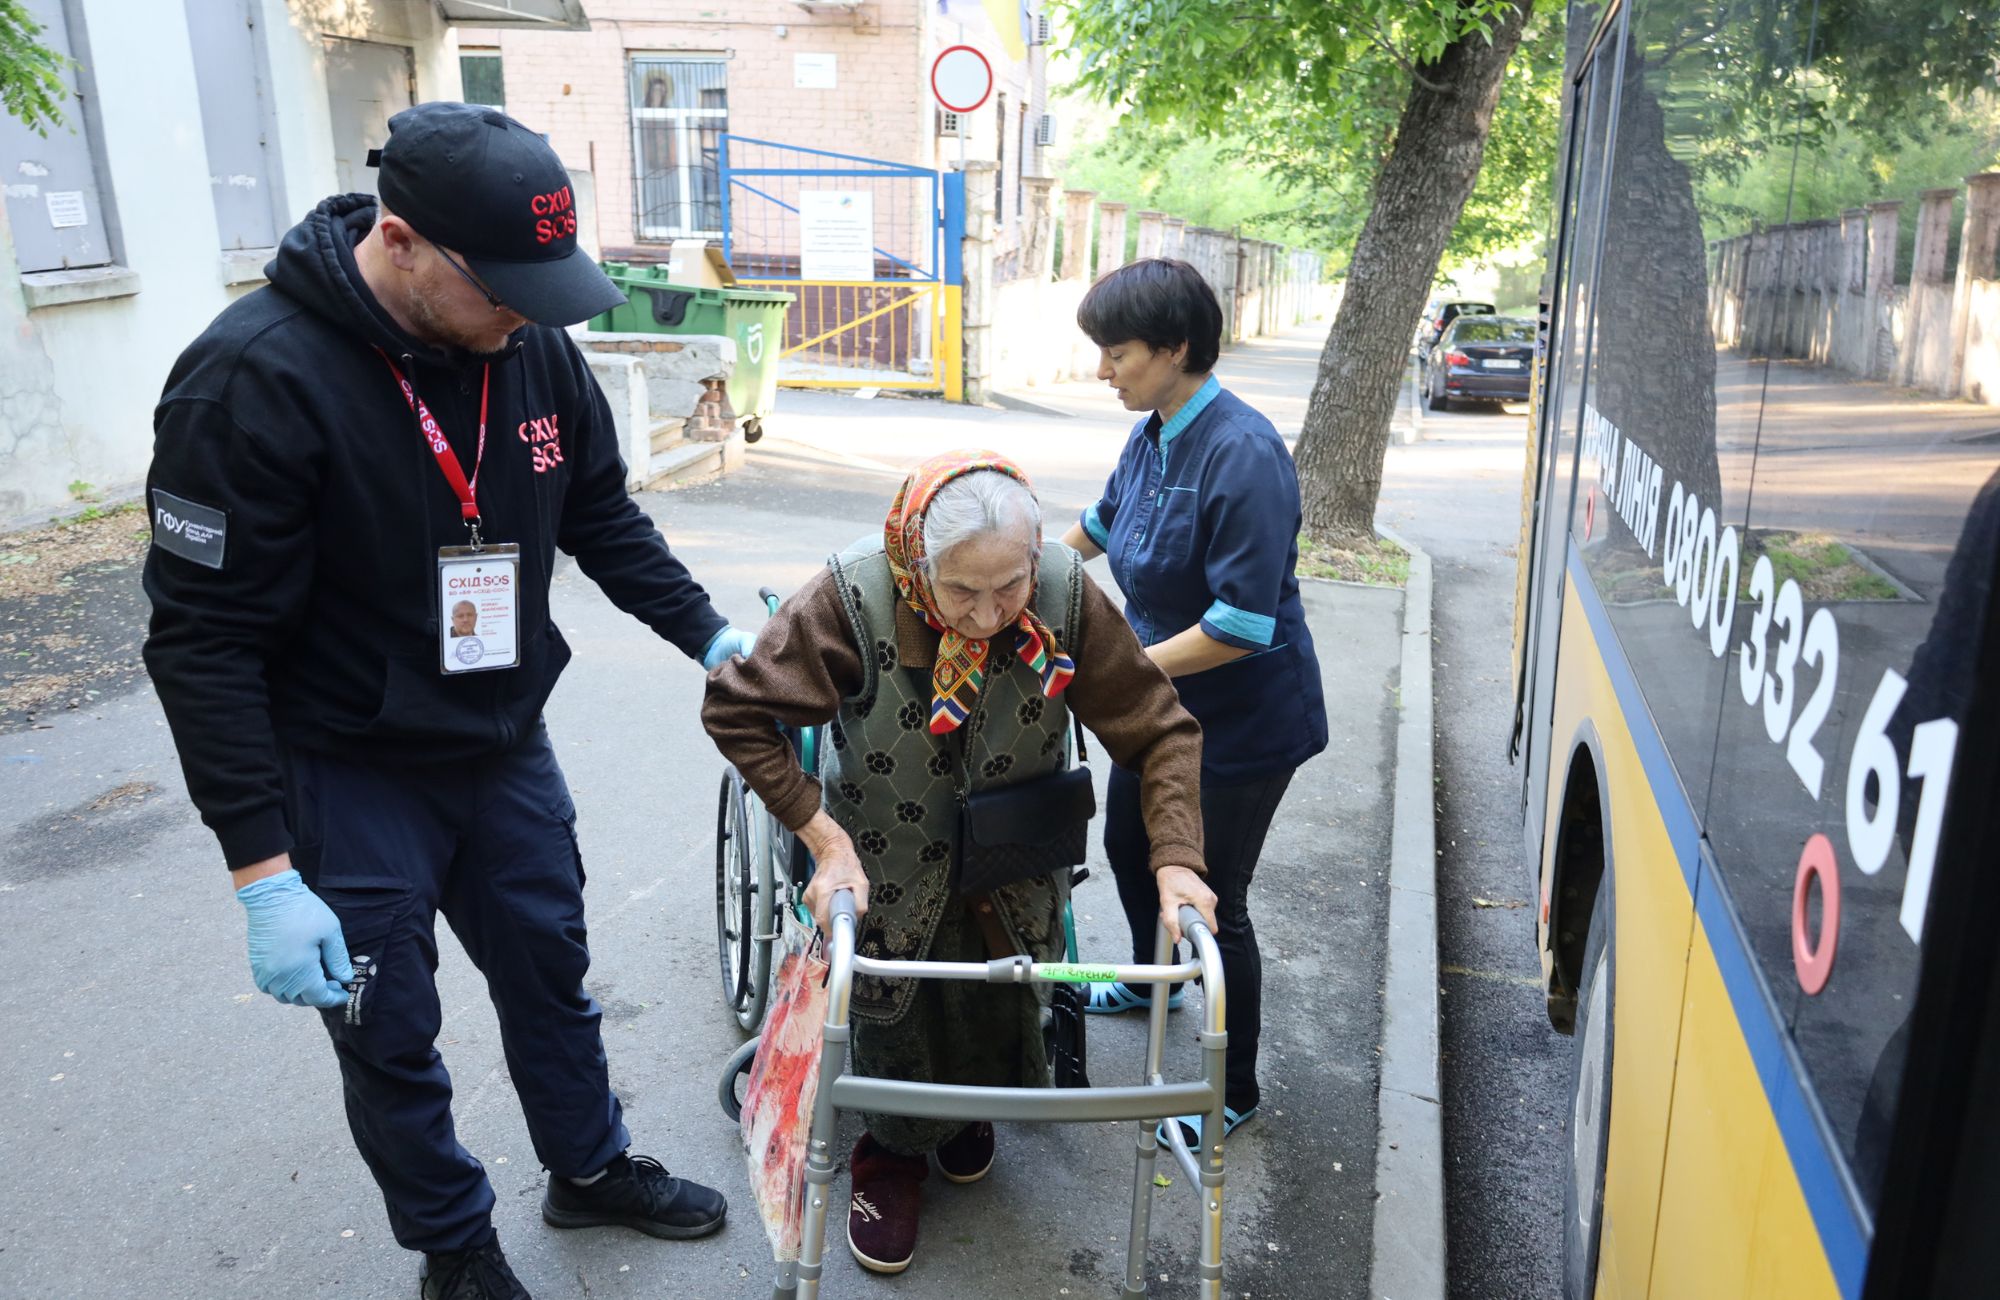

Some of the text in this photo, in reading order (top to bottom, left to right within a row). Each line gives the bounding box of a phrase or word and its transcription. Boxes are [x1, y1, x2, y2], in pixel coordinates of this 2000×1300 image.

[535, 209, 577, 245] SOS
[422, 419, 448, 454] SOS
[157, 507, 186, 535] ГФУ
[448, 575, 510, 589] СХІД SOS
[1615, 436, 1663, 559] ЛІНІЯ
[1663, 481, 1738, 658] 0800
[1740, 554, 1839, 801] 332
[1846, 667, 1959, 946] 61
